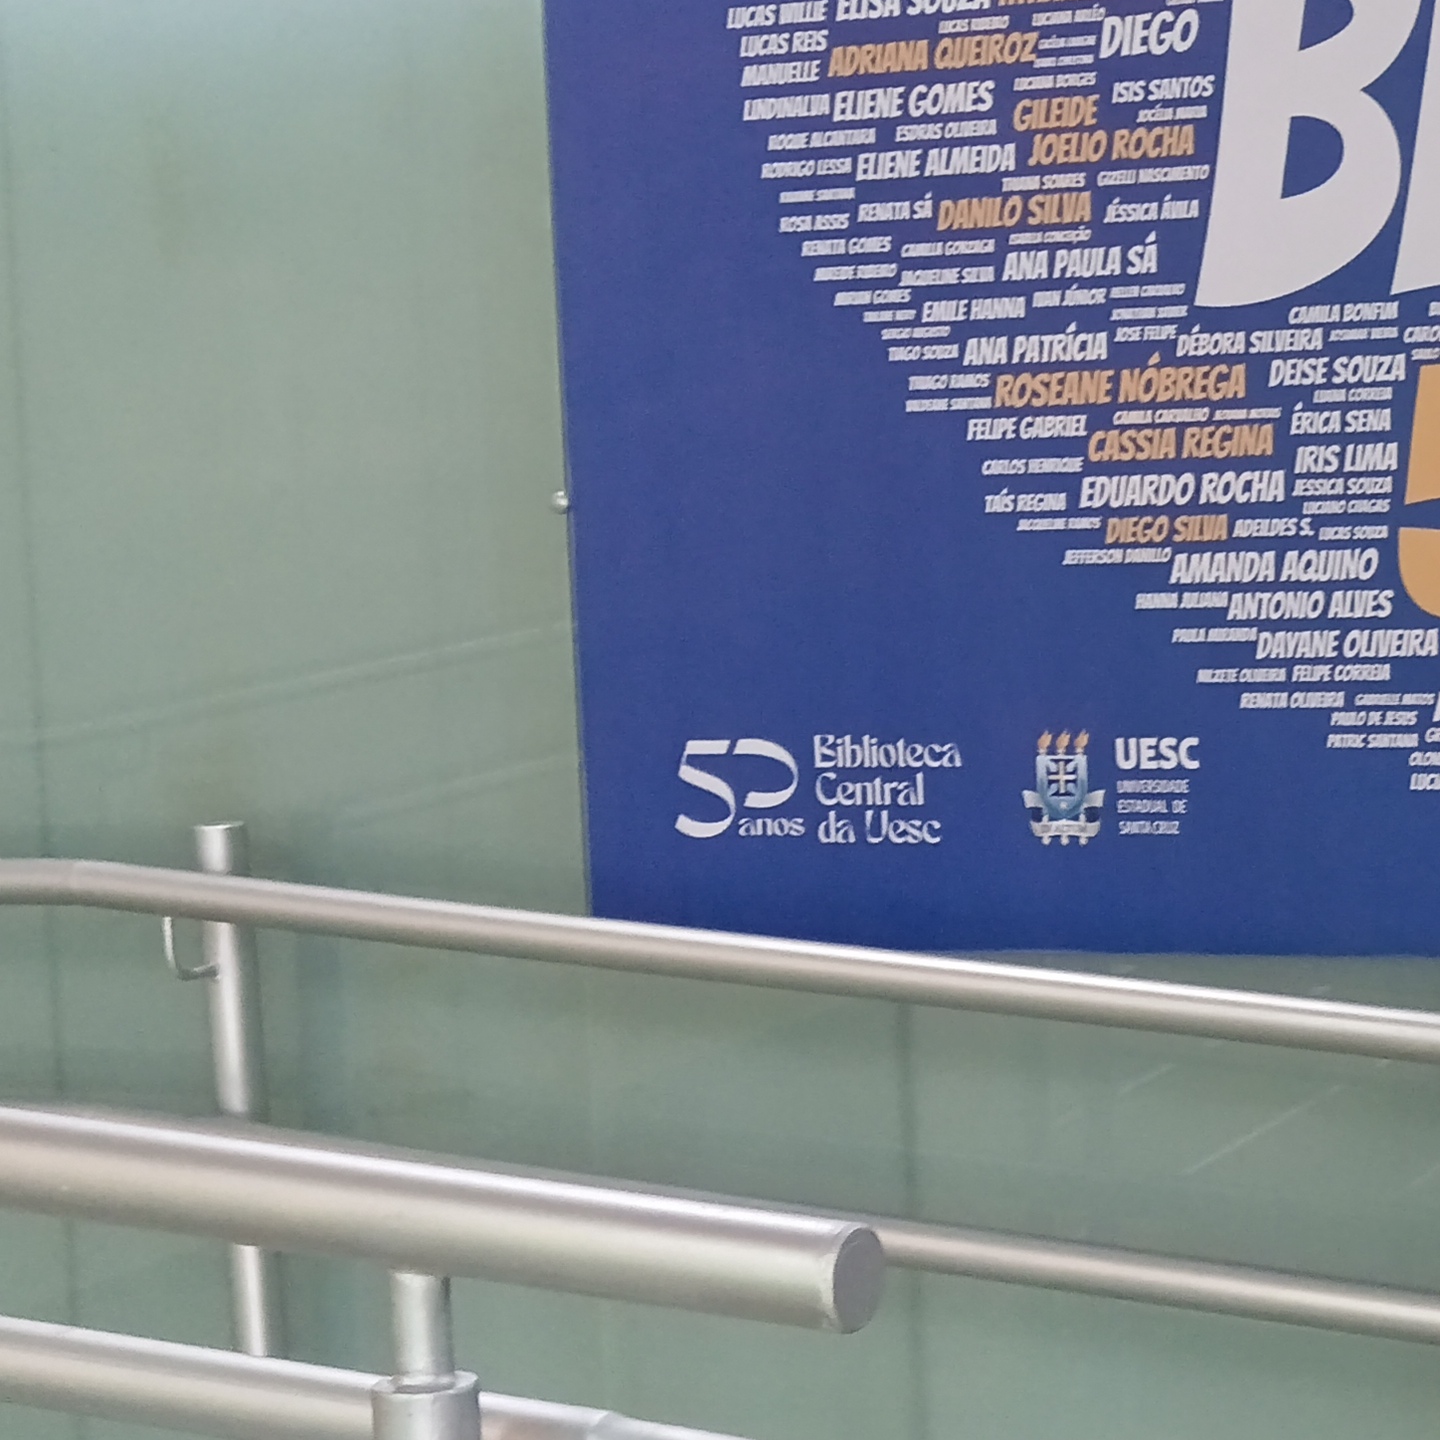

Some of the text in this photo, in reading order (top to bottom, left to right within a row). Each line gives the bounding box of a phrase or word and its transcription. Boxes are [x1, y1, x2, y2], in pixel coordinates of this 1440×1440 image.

[1099, 9, 1199, 58] DIEGO
[828, 40, 928, 77] ADRIANA
[934, 32, 1040, 69] QUEIROZ
[1014, 95, 1099, 131] GILEIDE
[1028, 125, 1194, 166] JOELIO ROCHA
[937, 191, 1091, 230] DANILO SILVA
[1002, 231, 1157, 281] ANA PAULA SÁ
[994, 352, 1245, 408] ROSEANE NÓBREGA
[1089, 424, 1273, 461] CASSIA REGINA
[1079, 470, 1284, 508] EDUARDO ROCHA
[1105, 514, 1227, 543] DIEGO SILVA
[1169, 548, 1378, 583] AMANDA AQUINO
[814, 735, 961, 767] Biblioteca
[1116, 737, 1199, 769] UESC
[816, 772, 924, 805] Central
[739, 818, 805, 836] anos
[818, 810, 941, 843] da Uesc
